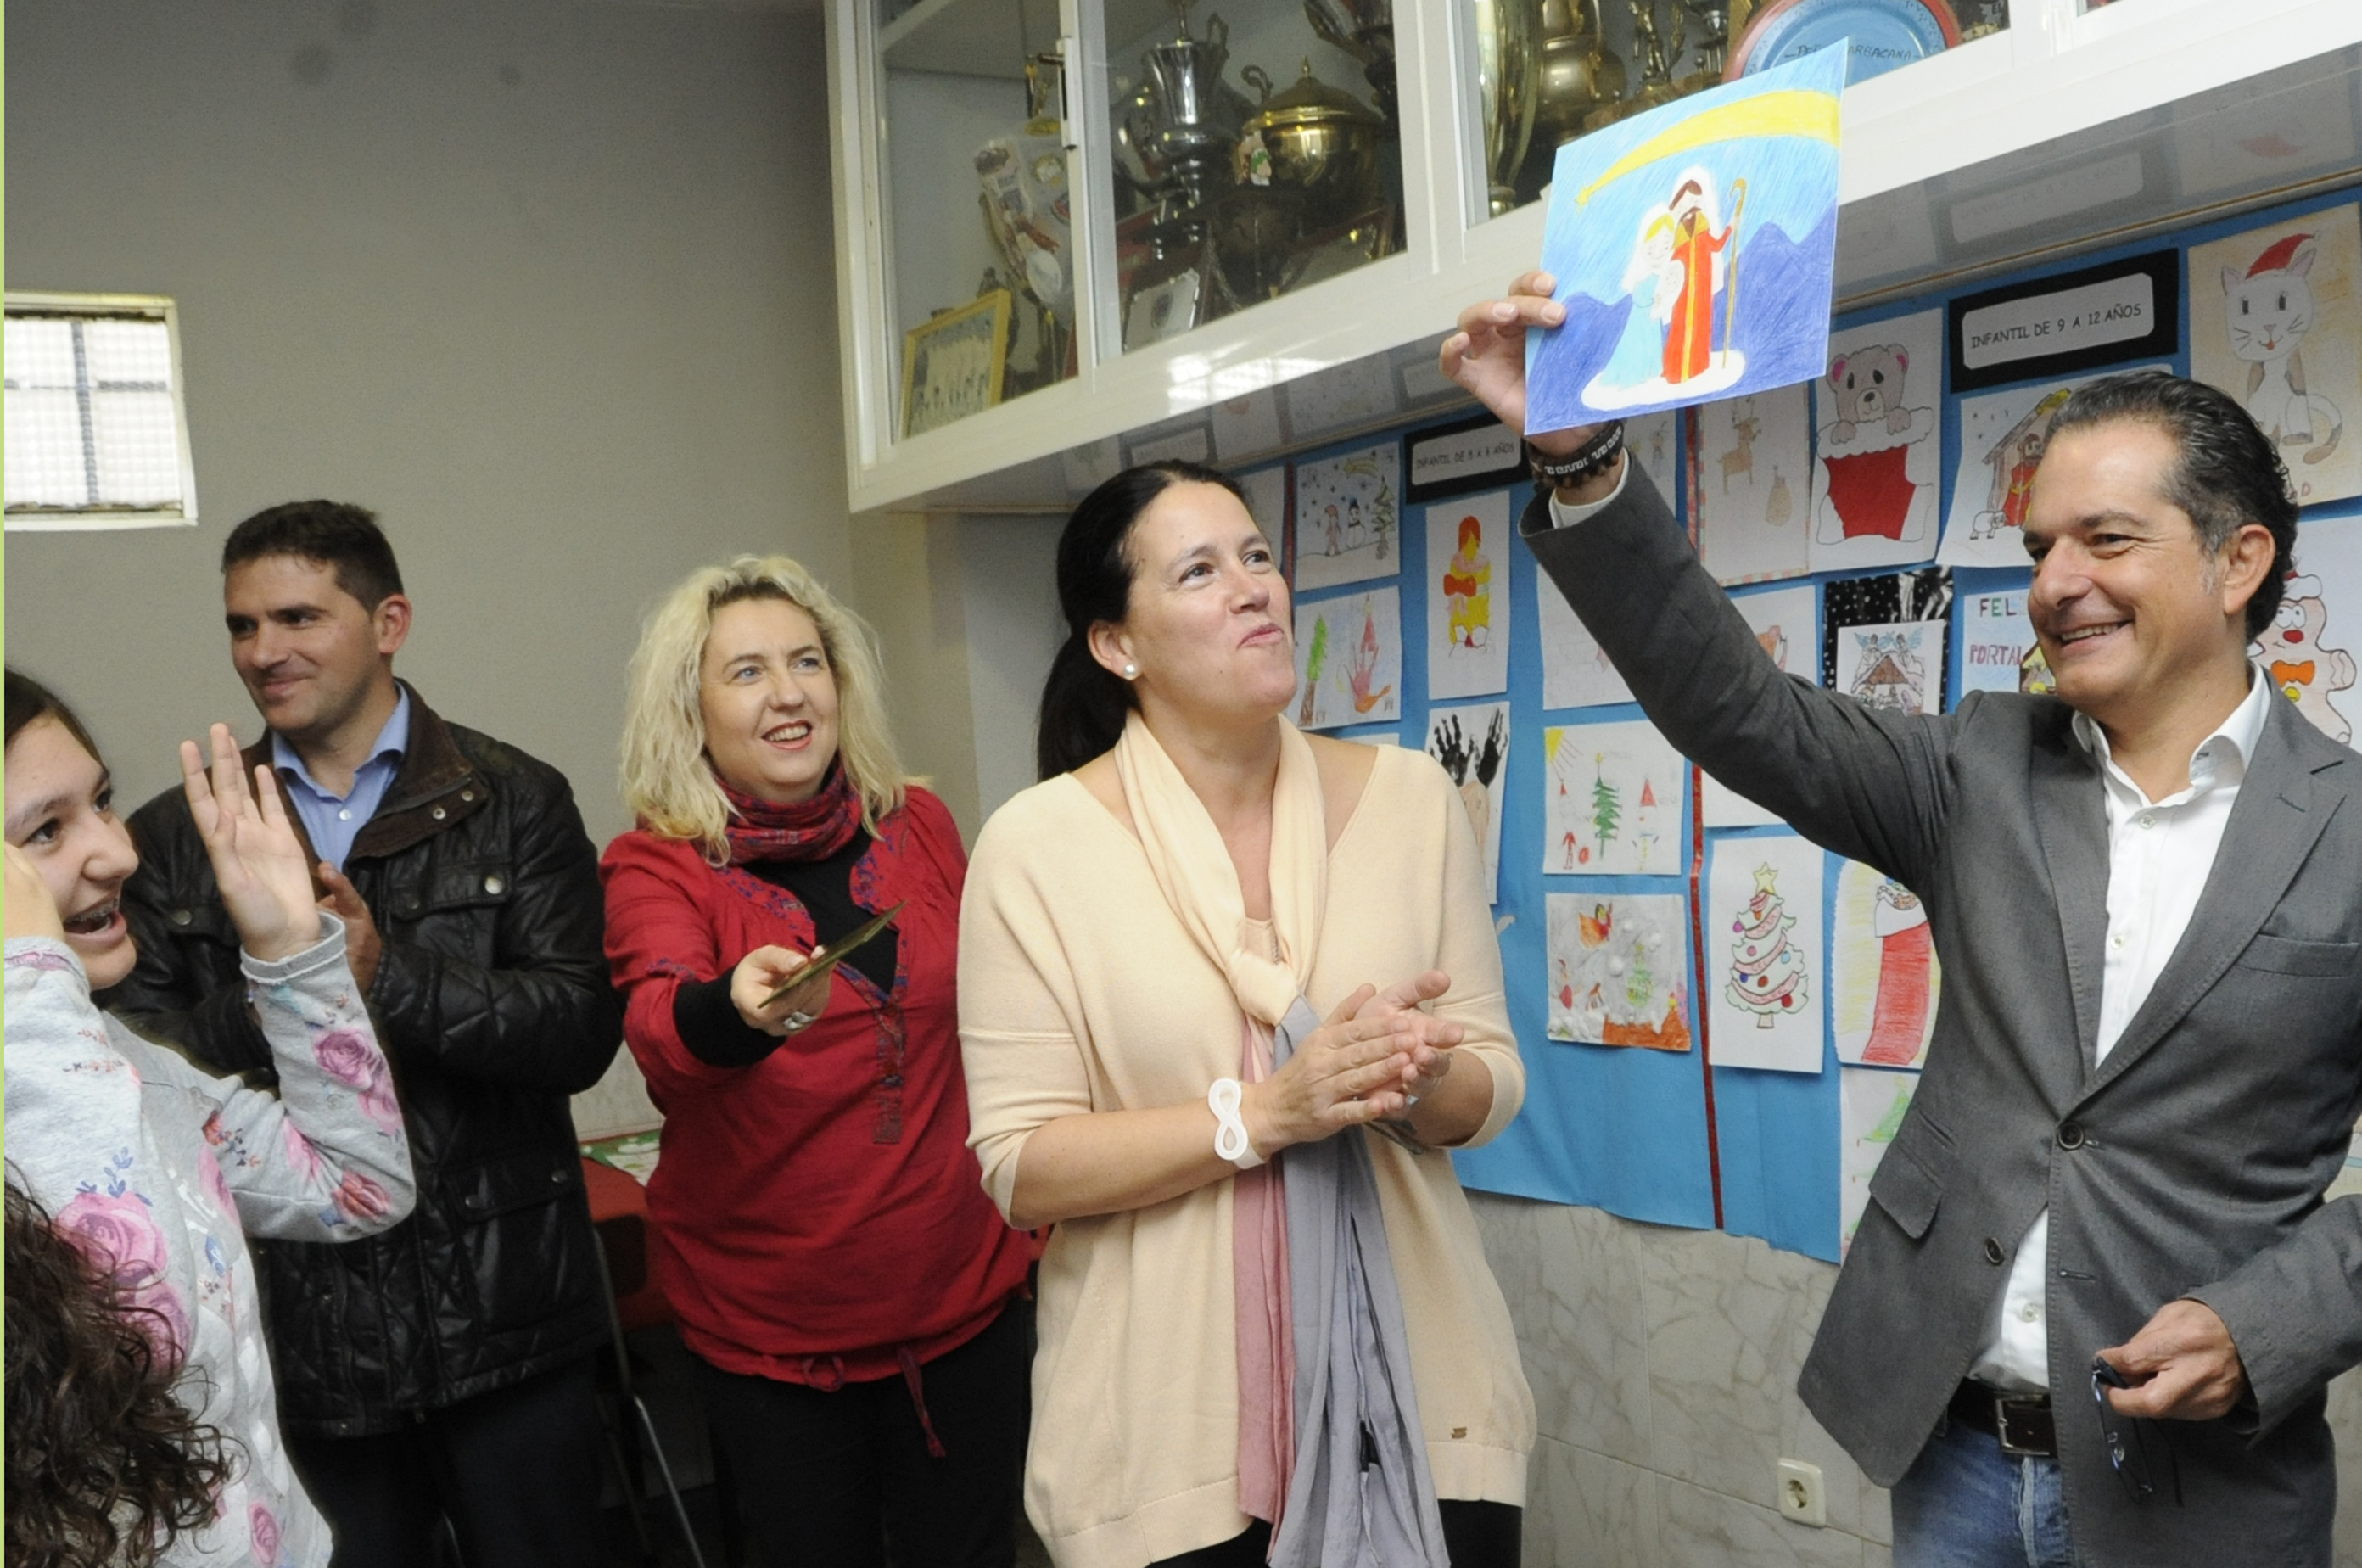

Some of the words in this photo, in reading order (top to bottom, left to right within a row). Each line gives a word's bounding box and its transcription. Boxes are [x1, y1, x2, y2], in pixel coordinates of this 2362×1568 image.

[1848, 45, 1911, 60] ARBACANA
[1971, 326, 2030, 349] INFANTIL
[2034, 321, 2051, 336] DE
[2057, 318, 2066, 332] 9
[2072, 316, 2081, 328] A
[2088, 311, 2101, 326] 12
[2105, 303, 2141, 322] AÑOS
[1454, 450, 1465, 462] DE
